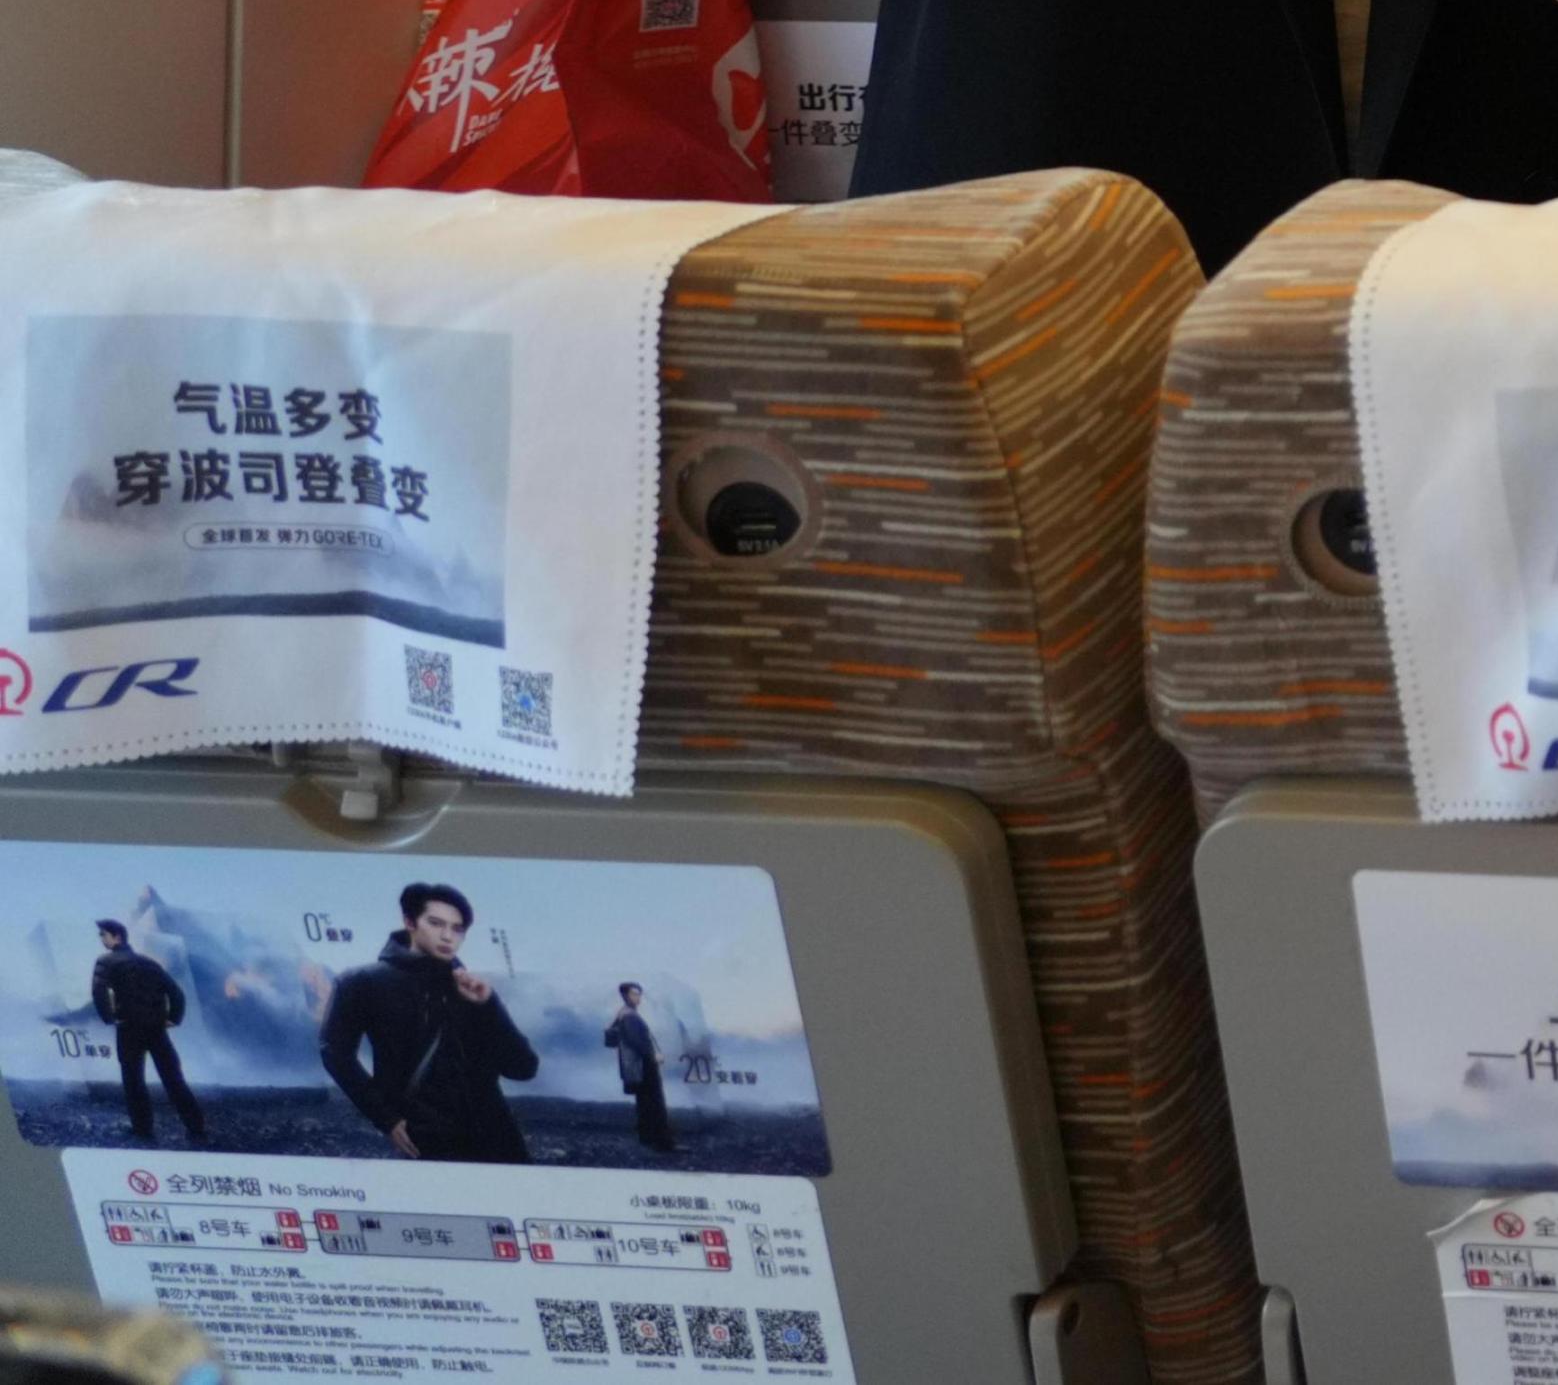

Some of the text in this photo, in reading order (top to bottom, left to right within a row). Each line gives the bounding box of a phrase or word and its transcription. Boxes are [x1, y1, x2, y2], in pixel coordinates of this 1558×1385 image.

[172, 380, 385, 445] 气温多变
[113, 449, 432, 523] 穿波司登叠变
[166, 1173, 367, 1202] 全列禁烟 No Smoking
[726, 1199, 762, 1215] 10kg
[199, 1219, 251, 1238] 8号车
[401, 1227, 455, 1247] 9号车
[617, 1236, 681, 1257] 10号车
